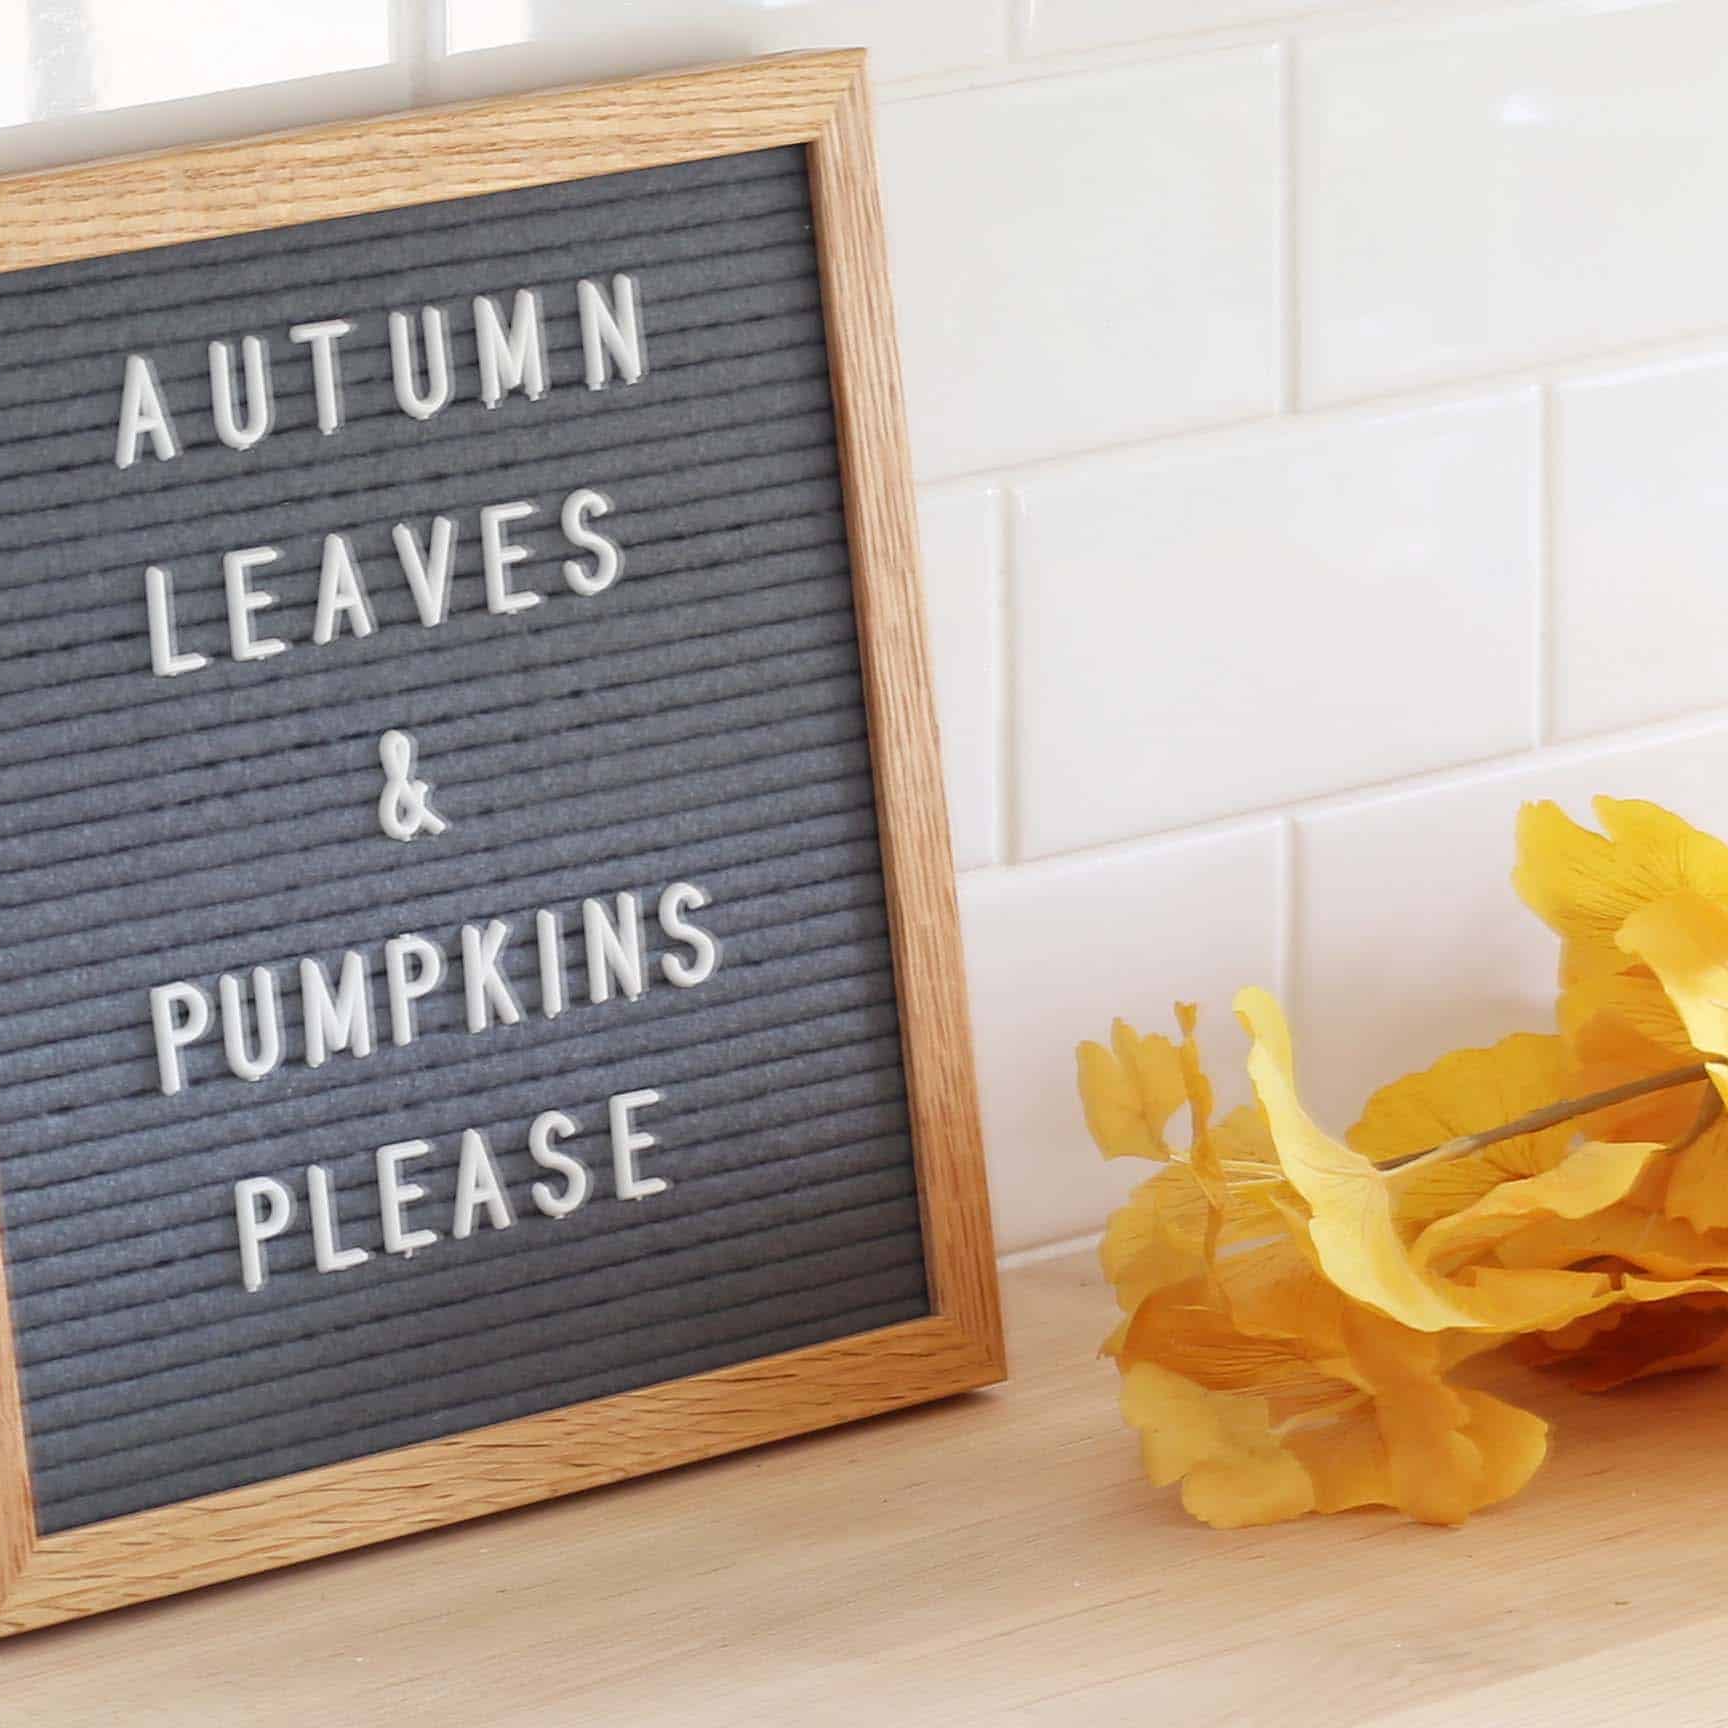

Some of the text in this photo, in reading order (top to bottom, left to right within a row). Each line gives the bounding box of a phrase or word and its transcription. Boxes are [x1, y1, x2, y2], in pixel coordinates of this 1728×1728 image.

[115, 274, 646, 470] AUTUMN
[145, 488, 624, 677] LEAVES
[377, 728, 446, 844] &
[148, 881, 722, 1096] PUMPKINS
[233, 1088, 670, 1294] PLEASE
